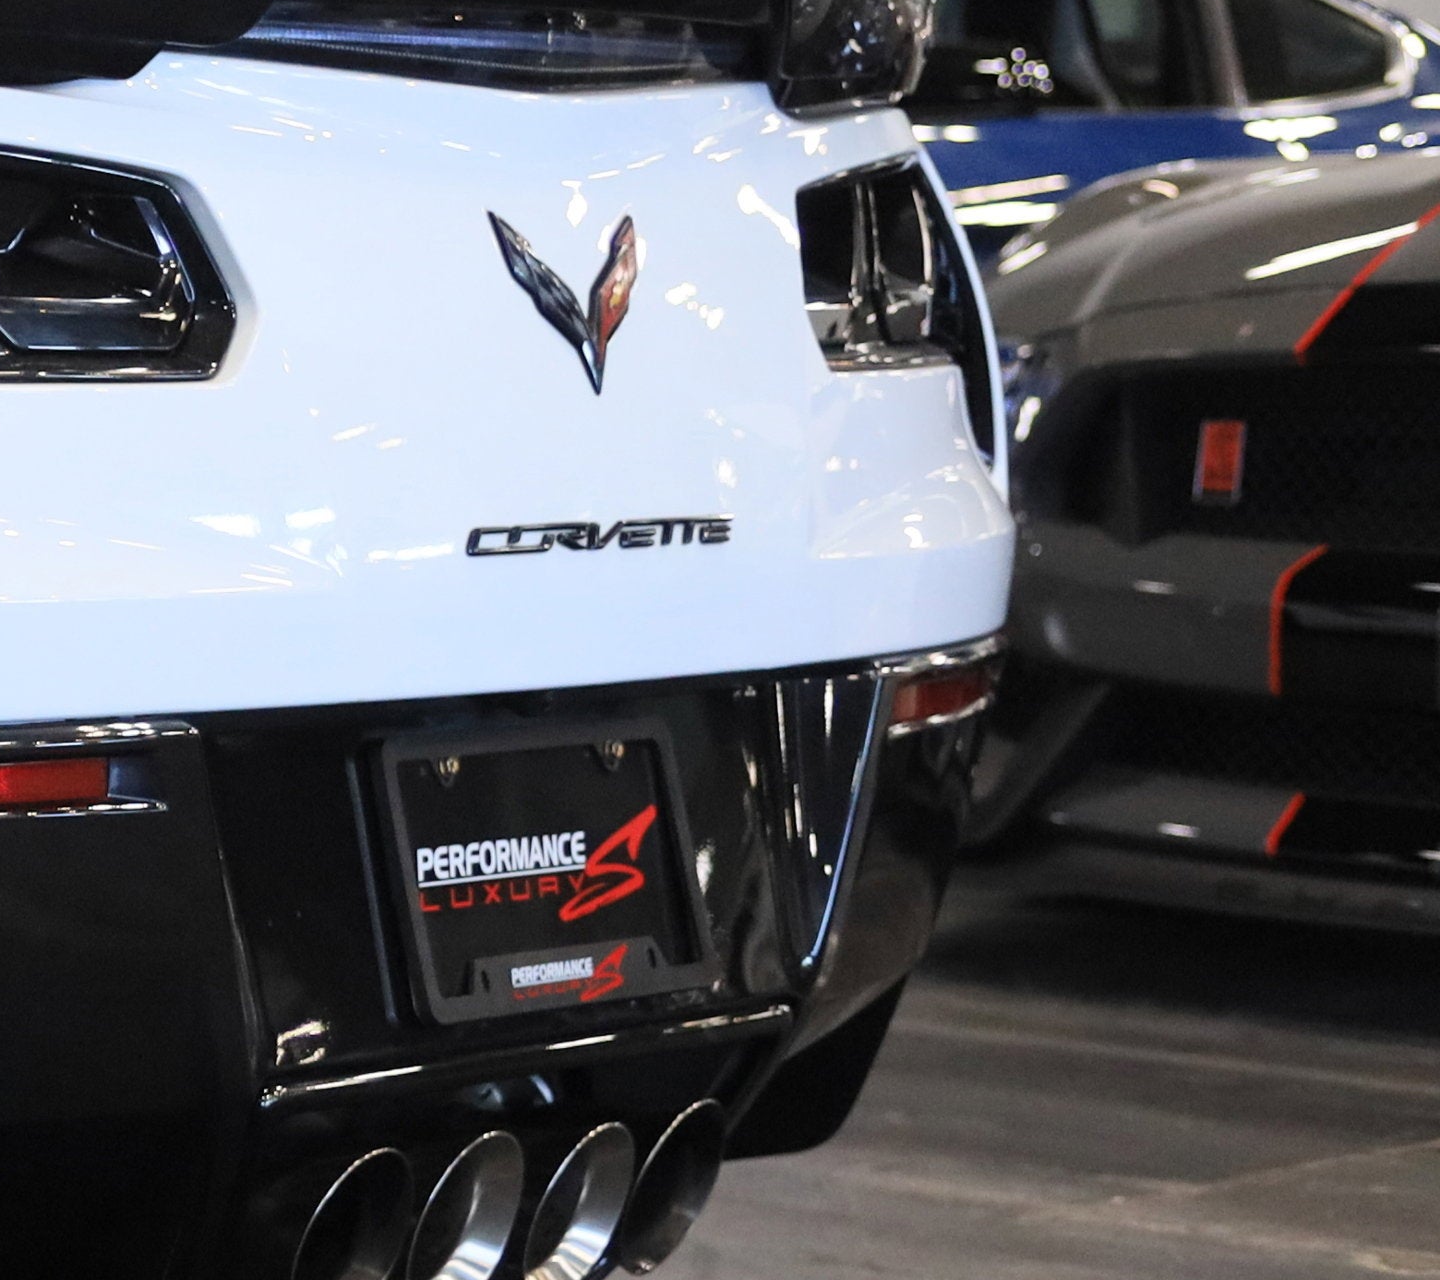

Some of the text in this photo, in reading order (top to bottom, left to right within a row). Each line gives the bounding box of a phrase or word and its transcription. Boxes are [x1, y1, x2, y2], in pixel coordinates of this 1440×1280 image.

[466, 513, 735, 557] CORVETTE
[416, 831, 586, 882] PERFORMANCE
[419, 876, 582, 912] LUXURY
[511, 957, 594, 986] PERFORMANCE
